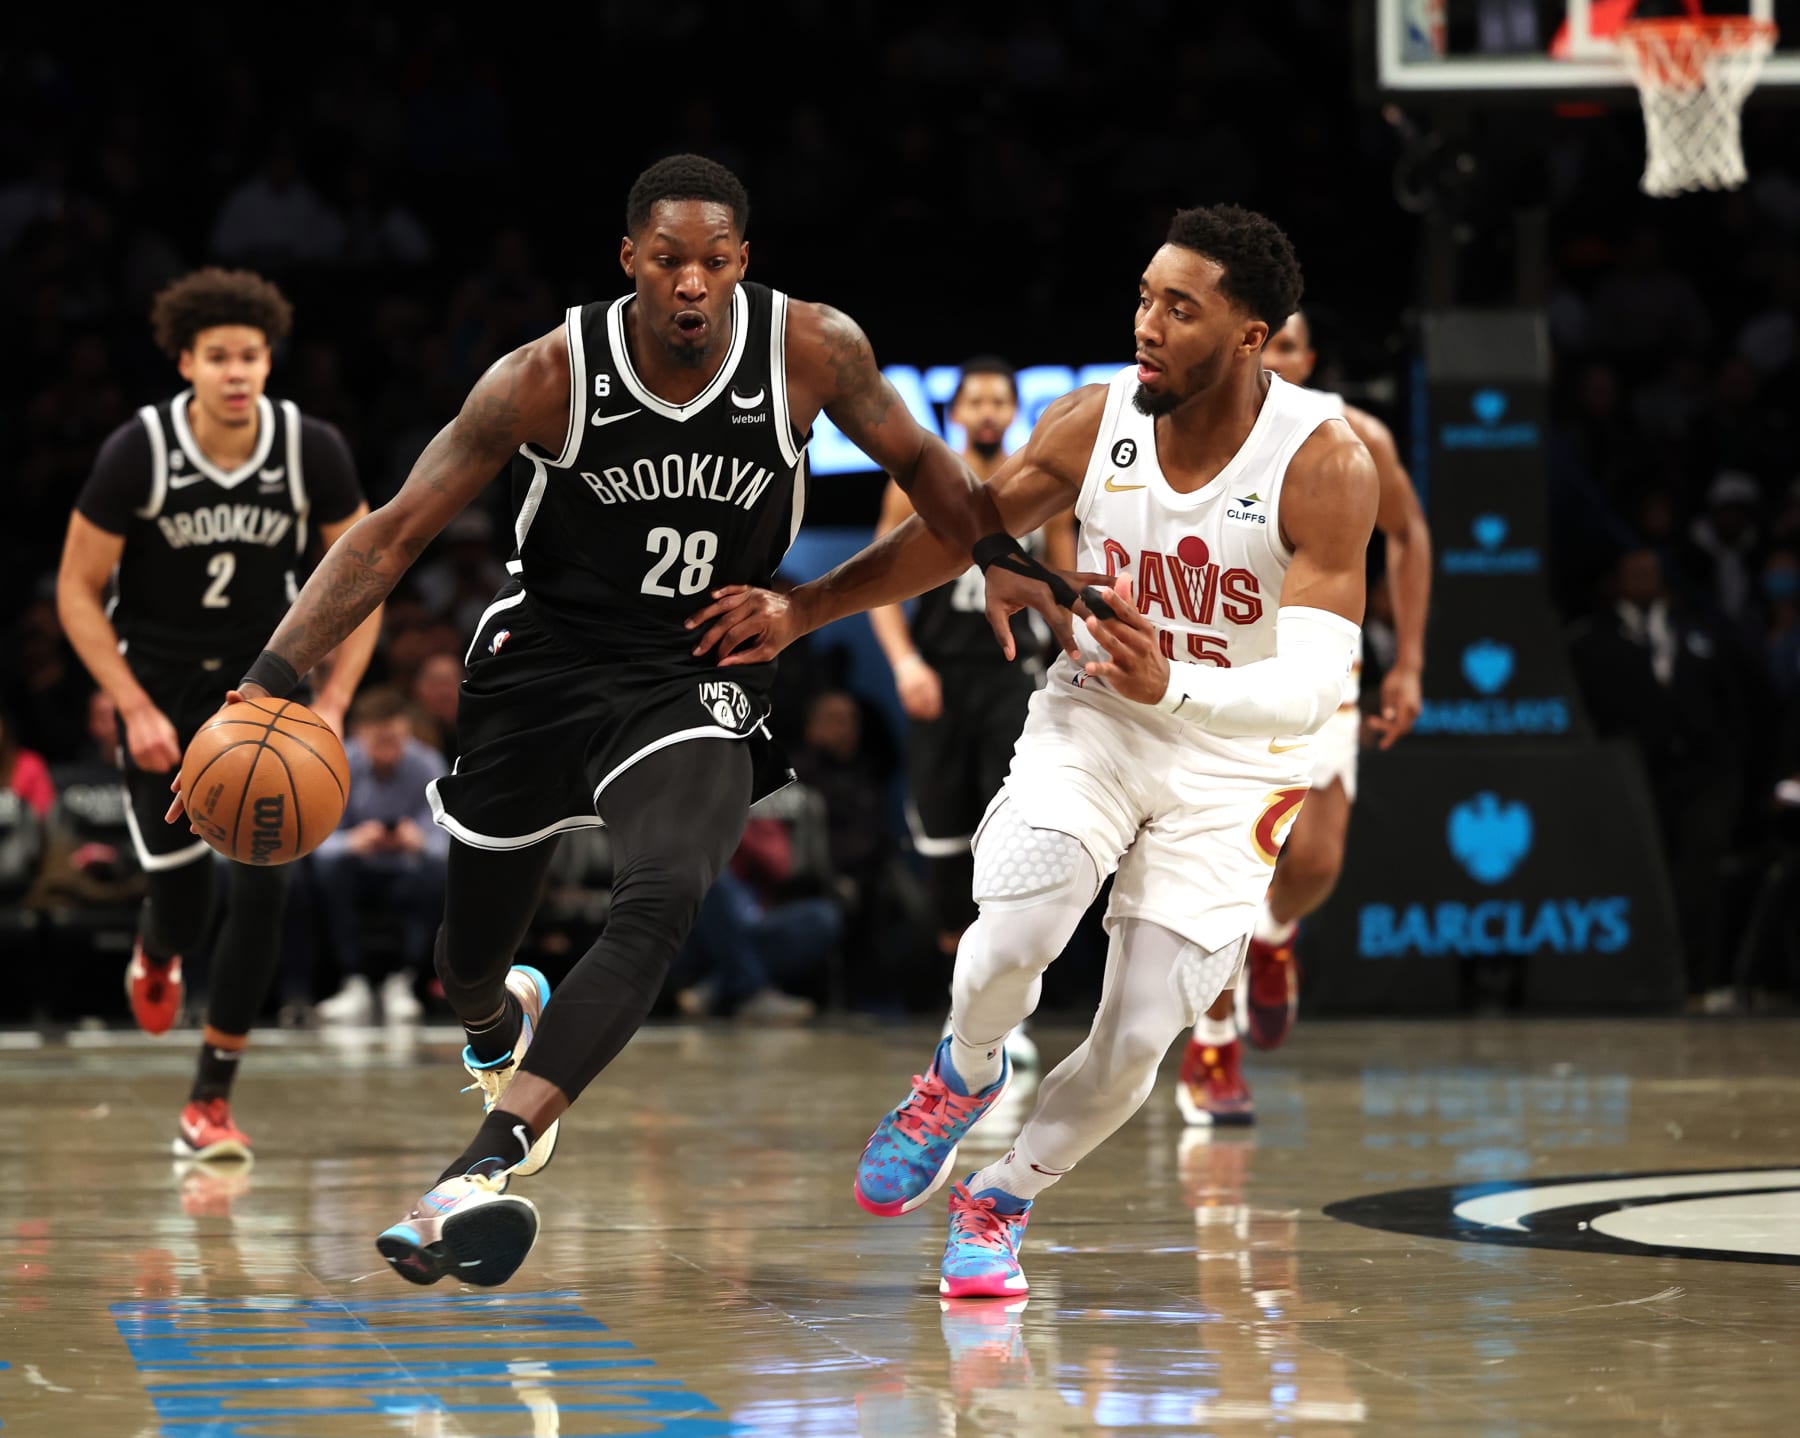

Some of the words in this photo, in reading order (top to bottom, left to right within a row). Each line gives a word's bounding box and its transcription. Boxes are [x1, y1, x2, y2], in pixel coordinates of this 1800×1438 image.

[594, 373, 611, 397] 6
[731, 412, 766, 425] Webull
[1114, 440, 1134, 468] 6
[580, 452, 775, 511] BROOKLYN
[157, 502, 292, 549] BROOKLYN
[1226, 508, 1267, 525] CLIFFS
[202, 551, 237, 609] 2
[640, 526, 719, 598] 28
[703, 681, 748, 720] NETS
[1358, 896, 1630, 958] BARCLAYS
